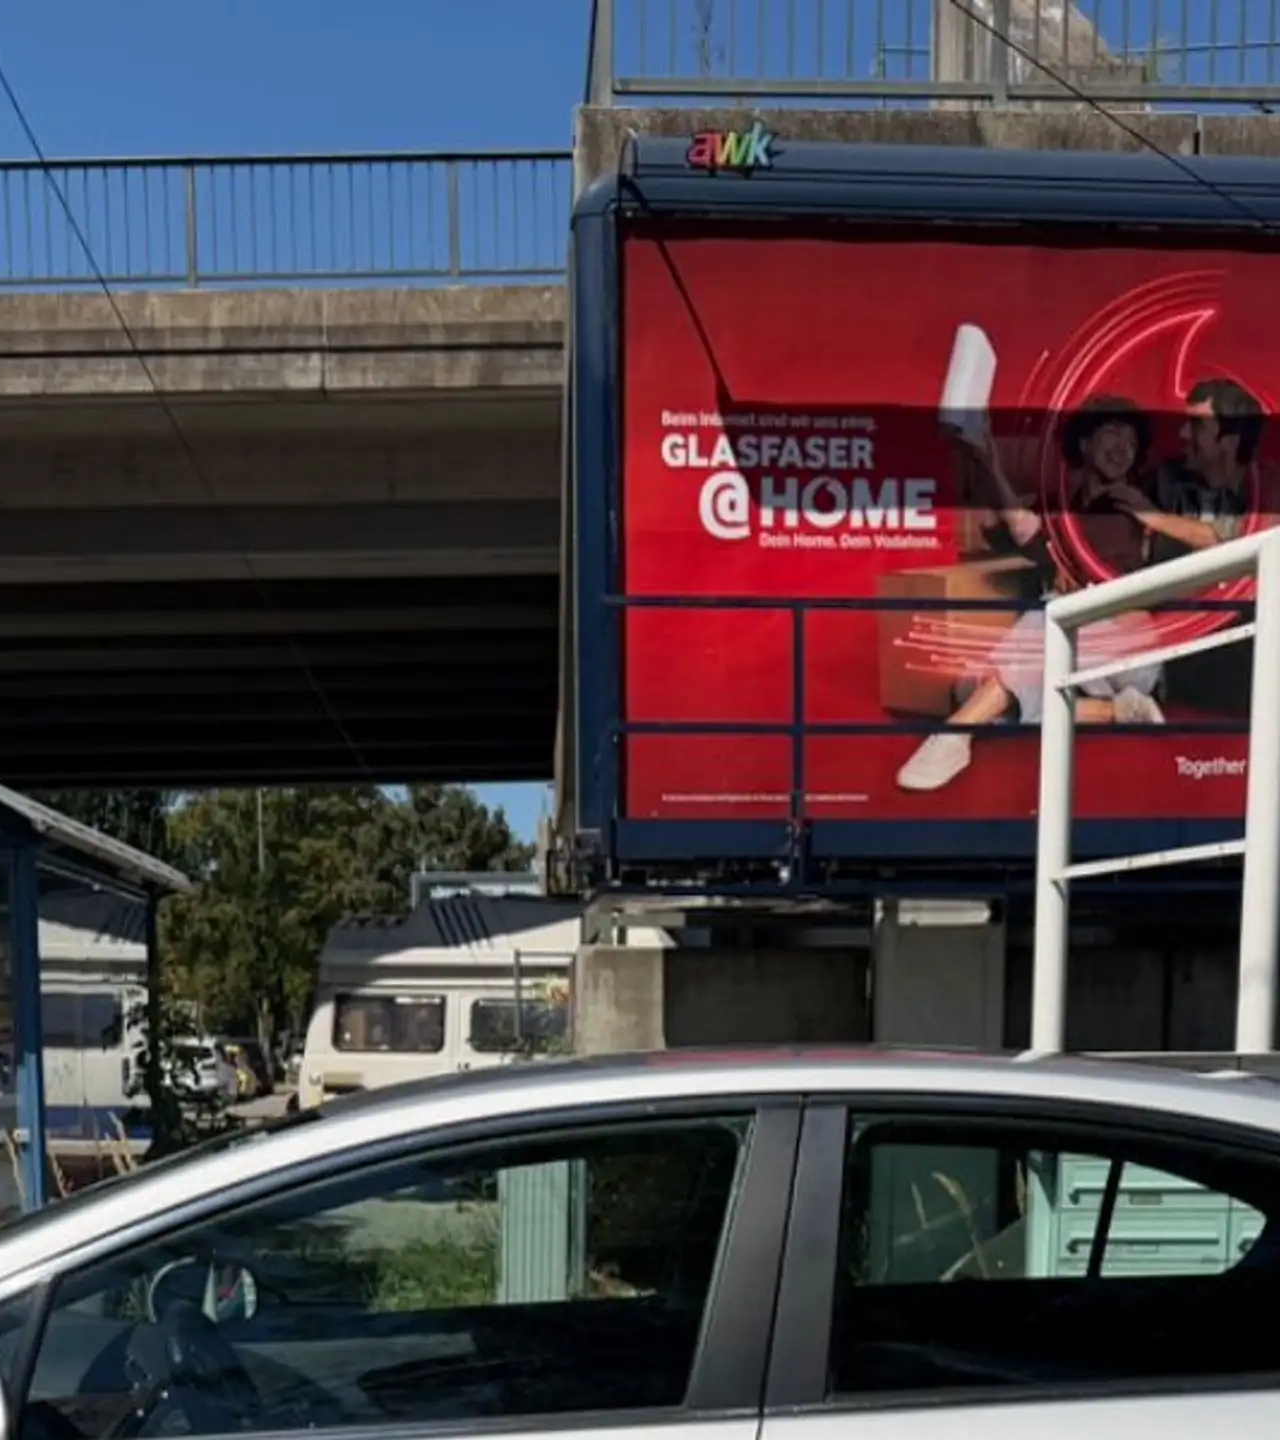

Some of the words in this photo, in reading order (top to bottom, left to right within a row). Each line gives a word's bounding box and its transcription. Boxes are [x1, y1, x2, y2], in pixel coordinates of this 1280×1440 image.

[687, 121, 775, 167] awk
[661, 409, 697, 428] Beim
[660, 433, 874, 470] GLASFASER
[759, 532, 790, 548] Dein
[840, 532, 871, 549] Dein
[1175, 756, 1247, 780] Together
